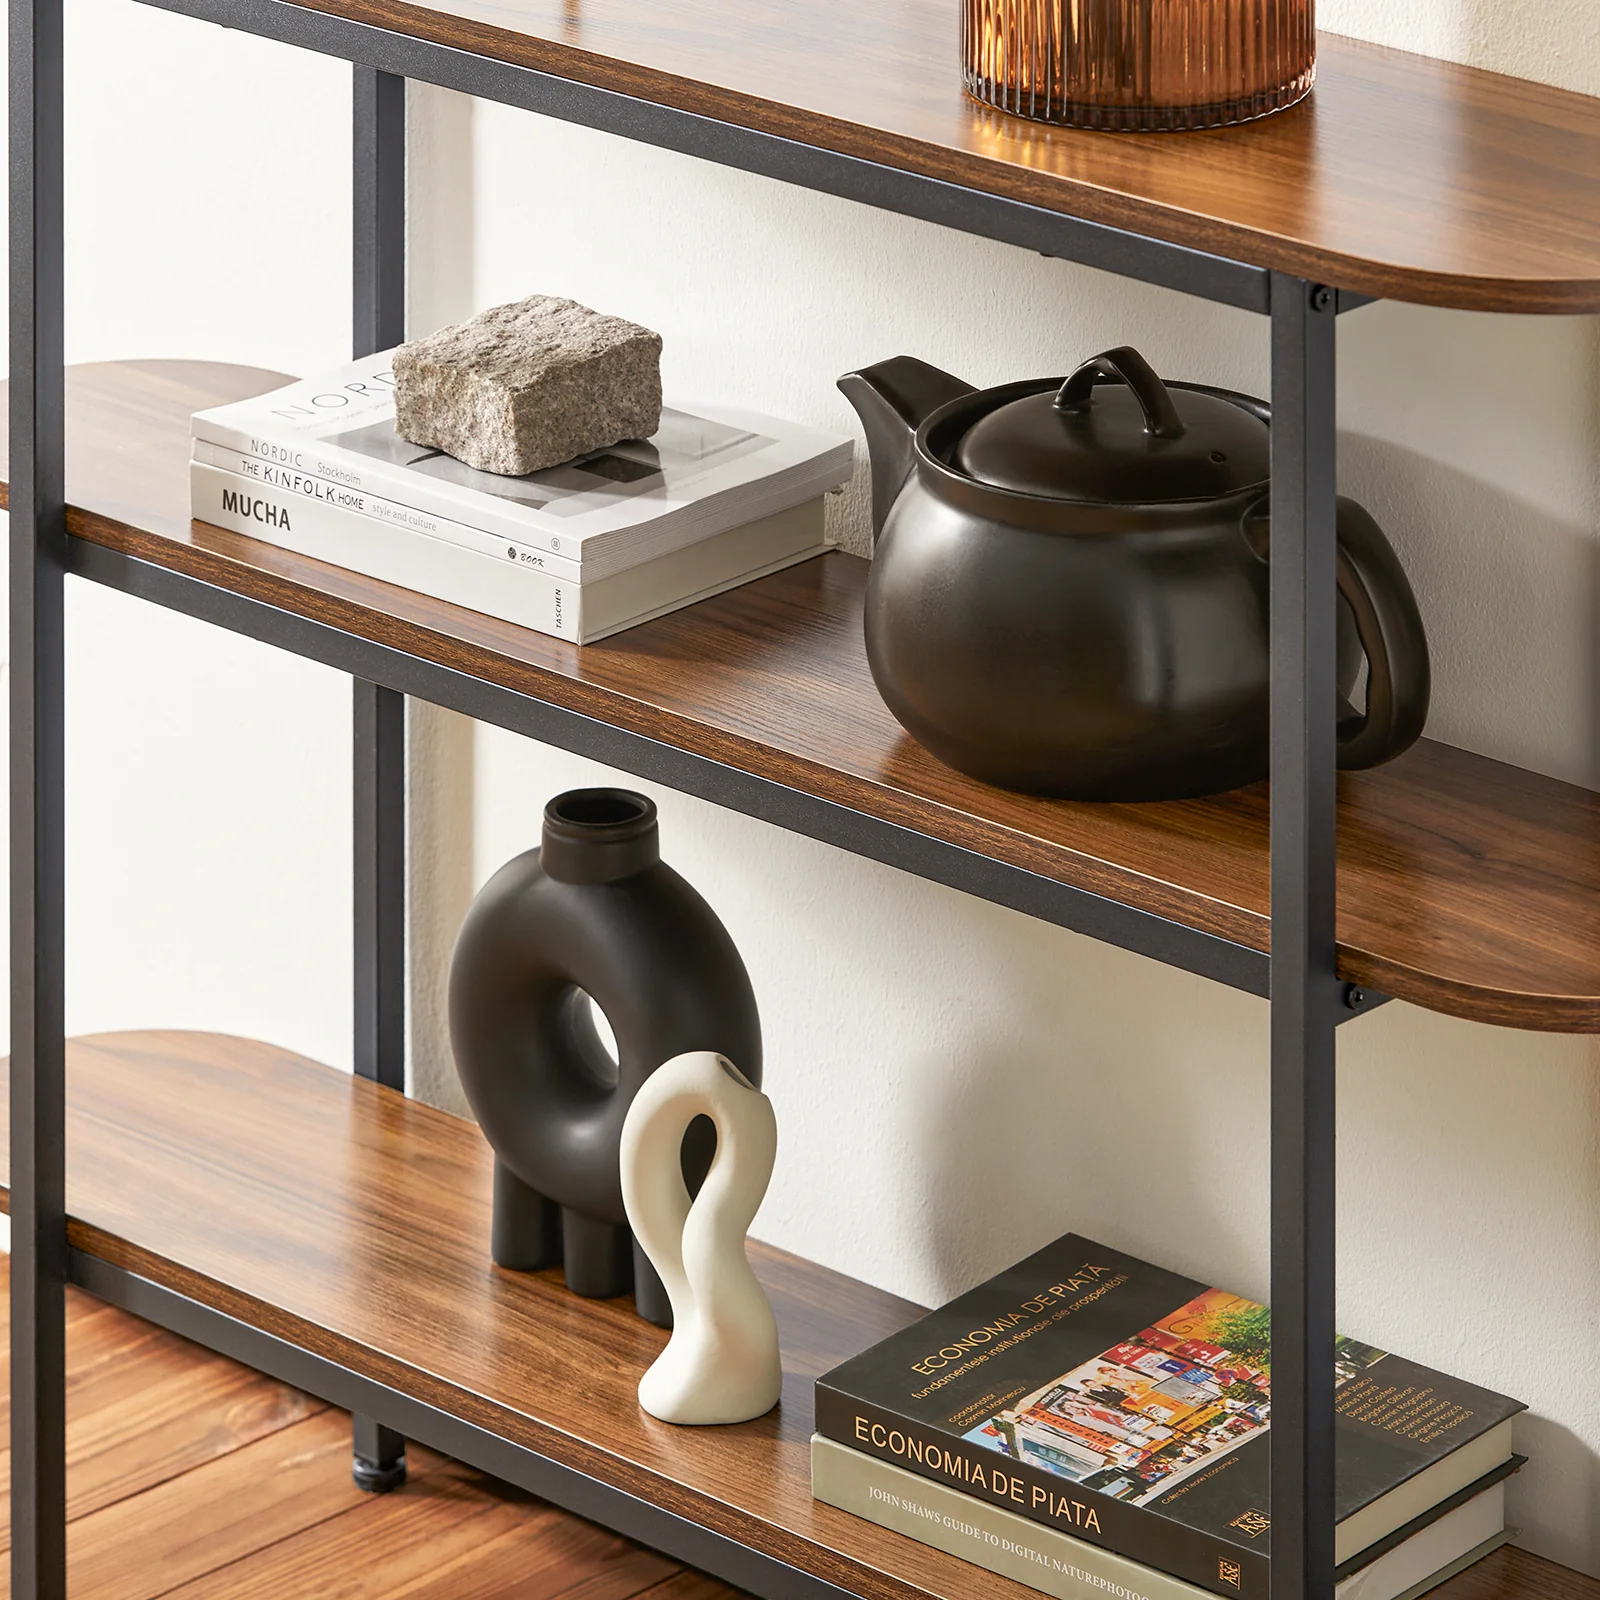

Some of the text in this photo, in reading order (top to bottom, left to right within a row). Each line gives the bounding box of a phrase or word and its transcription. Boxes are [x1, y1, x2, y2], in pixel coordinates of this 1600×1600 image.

[250, 439, 361, 485] NORDIC Stockholm
[222, 488, 291, 531] MUCHA
[241, 460, 437, 531] THE KINFOLK HOME style and culture
[520, 552, 545, 568] BOOK
[554, 588, 562, 629] TASCHEN
[911, 1312, 1030, 1376] ECONOMIA
[1020, 1293, 1057, 1314] DE
[911, 1353, 989, 1400] fundamentele
[1051, 1308, 1071, 1322] ale
[948, 1392, 996, 1423] coordonator
[957, 1405, 988, 1428] Cosmin
[987, 1385, 1026, 1411] Marinescu
[854, 1415, 1102, 1534] ECONOMIA DE PIATA
[869, 1486, 900, 1508] JOHN
[902, 1499, 941, 1523] SHAWS
[942, 1515, 981, 1540] GUIDE
[983, 1530, 999, 1547] TO
[1001, 1538, 1051, 1568] DIGITAL
